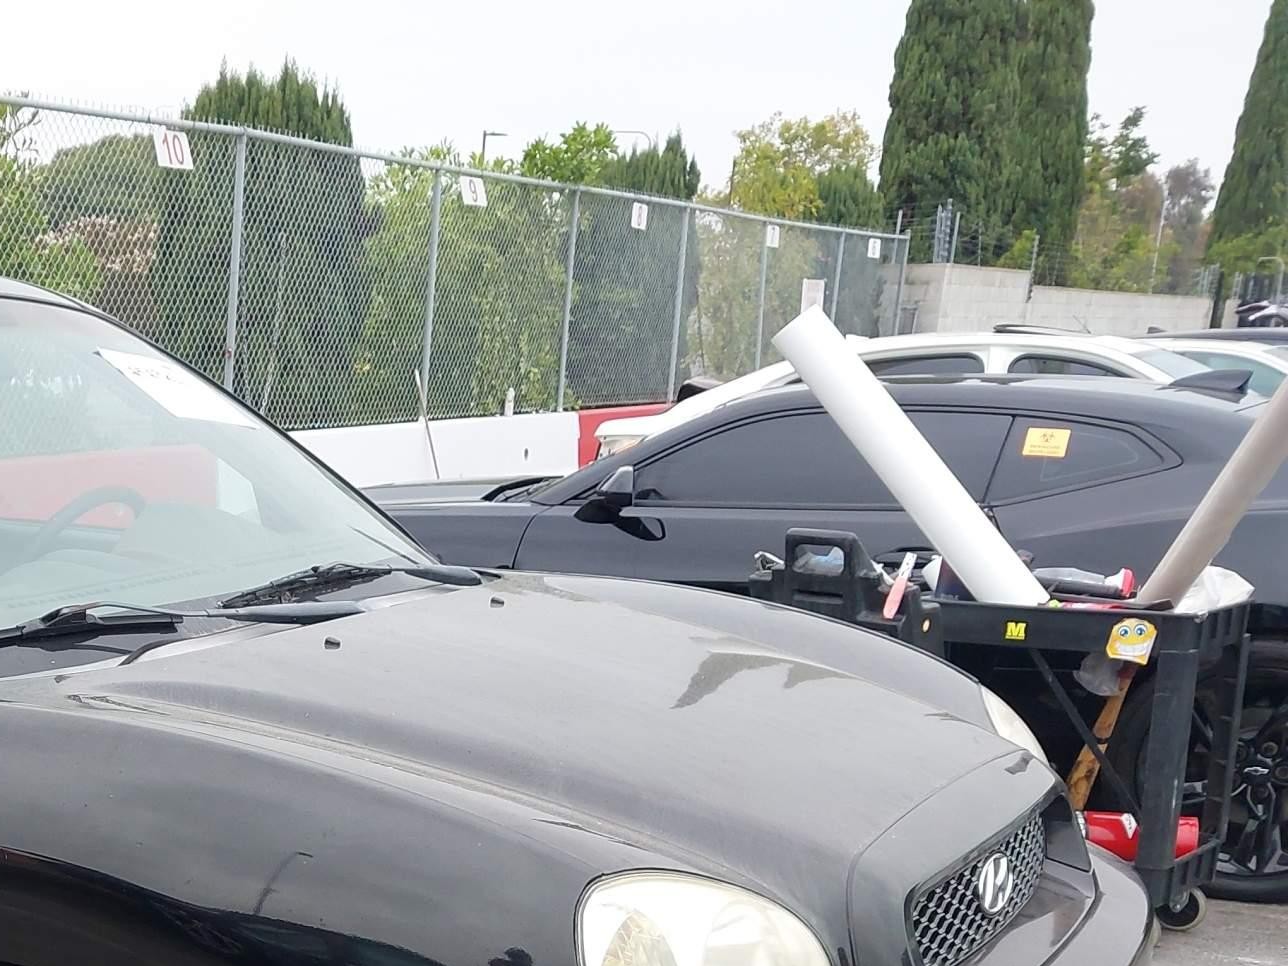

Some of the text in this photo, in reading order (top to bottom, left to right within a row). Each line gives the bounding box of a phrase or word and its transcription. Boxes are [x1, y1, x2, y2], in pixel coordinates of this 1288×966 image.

[162, 132, 185, 166] 10
[469, 179, 479, 203] 9
[1006, 622, 1027, 637] M
